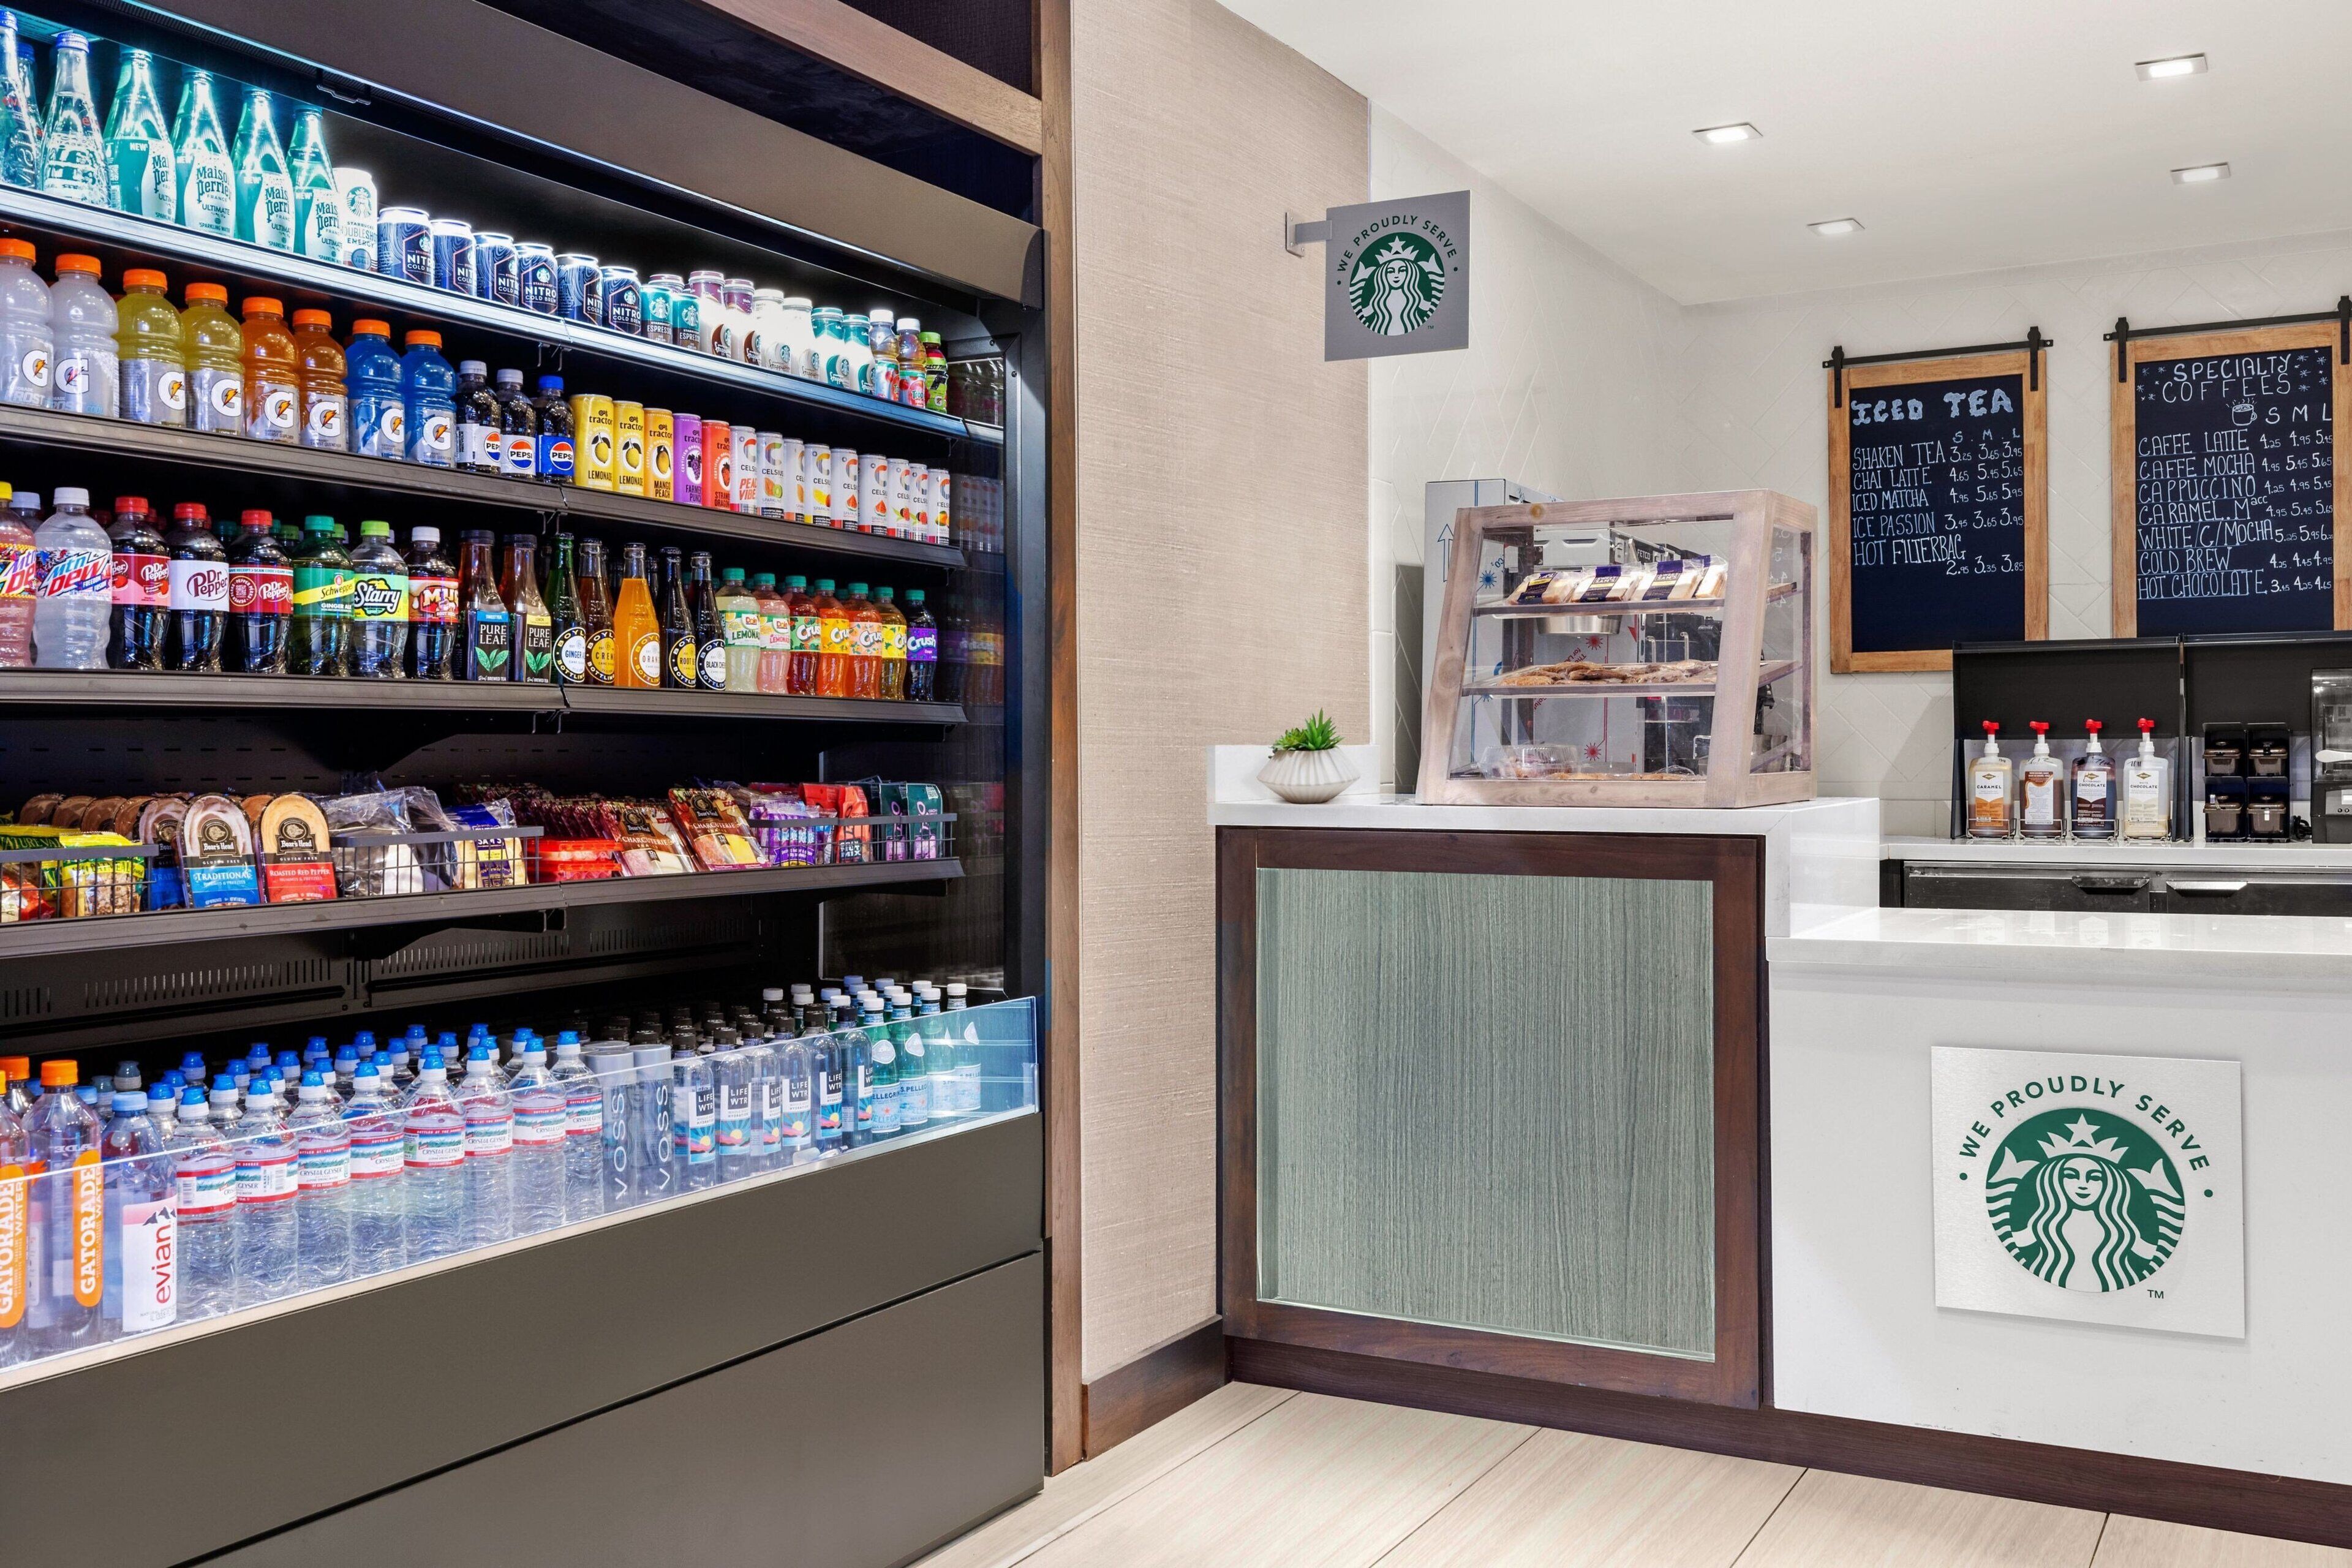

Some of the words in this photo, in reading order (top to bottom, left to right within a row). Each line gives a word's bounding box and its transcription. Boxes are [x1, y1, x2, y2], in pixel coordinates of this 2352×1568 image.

[202, 204, 230, 215] ULTIMATE
[347, 238, 374, 247] ENERGY
[1338, 250, 1353, 272] WE
[1354, 215, 1418, 246] PROUDLY
[1422, 221, 1457, 258] SERVE
[526, 287, 556, 297] NITRO
[612, 307, 640, 319] NITRO
[647, 325, 671, 334] ESPRESSO
[2173, 353, 2291, 382] SPECIALTY
[55, 358, 89, 394] G
[2162, 373, 2291, 404] COFFEES
[265, 391, 294, 428] G
[1850, 399, 1923, 426] ICED
[1943, 388, 2013, 418] TEA
[2266, 407, 2280, 424] S
[2292, 404, 2308, 422] M
[2323, 403, 2332, 421] L
[309, 402, 340, 437] G
[589, 416, 612, 425] tractor
[620, 421, 643, 431] tractor
[423, 417, 451, 450] G
[649, 430, 672, 439] tractor
[1952, 431, 1962, 443] S
[1983, 428, 1993, 440] M
[2013, 428, 2020, 439] L
[2138, 433, 2193, 458] CAFFE
[2204, 429, 2249, 452] LATTE
[2260, 434, 2281, 449] 4.25
[2290, 430, 2310, 447] 4.95
[1852, 444, 1904, 470] SHAKEN
[1912, 440, 1946, 466] TEA
[1950, 446, 1972, 462] 3.25
[1978, 443, 1999, 460] 3.65
[2003, 441, 2022, 458] 3.95
[2139, 456, 2197, 480] CAFFE
[2204, 453, 2255, 476] MOCHA
[2261, 458, 2280, 472] 4.95
[2286, 455, 2308, 470] 5.45
[2312, 453, 2332, 467] 5.65
[588, 470, 612, 481] LEMONADE
[619, 475, 643, 486] LEMONADE
[1853, 469, 1882, 491] CHAI
[1891, 466, 1932, 488] LATTE
[1950, 467, 1969, 483] 4.65
[1978, 463, 1999, 480] 5.45
[2001, 461, 2024, 479] 5.65
[654, 481, 671, 491] MANGO
[655, 489, 670, 498] PEACH
[2139, 475, 2256, 504] CAPPUCCINO
[2264, 480, 2285, 495] 4.25
[2290, 478, 2310, 492] 4.95
[2313, 476, 2332, 490] 5.45
[1852, 492, 1877, 512] ICED
[1882, 489, 1929, 510] MATCHA
[1950, 488, 1969, 503] 4.95
[1975, 485, 1998, 502] 5.65
[2002, 483, 2023, 499] 5.95
[2266, 505, 2287, 517] 4.95
[2291, 502, 2313, 516] 5.45
[2316, 500, 2333, 514] 5.65
[1853, 515, 1875, 538] ICE
[1880, 511, 1936, 537] PASSION
[1945, 514, 1967, 530] 3.45
[1973, 510, 1997, 529] 3.65
[2000, 508, 2024, 526] 3.95
[2275, 529, 2297, 543] 5.25
[2299, 525, 2320, 541] 5.95
[1637, 549, 1651, 560] FETCO
[1854, 539, 1886, 566] HOT
[1892, 533, 1966, 564] FILTERBAG
[154, 562, 163, 571] Dr
[1947, 560, 1969, 575] 2.95
[1974, 555, 1997, 574] 3.35
[2002, 554, 2024, 573] 3.85
[2139, 549, 2180, 575] COLD
[2185, 546, 2233, 573] BREW
[2269, 553, 2287, 568] 4.25
[2293, 552, 2312, 567] 4.45
[2313, 550, 2334, 567] 4.95
[194, 572, 228, 597] Pepper
[207, 570, 221, 584] Dr
[2138, 574, 2166, 599] HOT
[2171, 569, 2267, 597] CHOCOLATE
[2271, 579, 2290, 593] 3.45
[2294, 576, 2313, 591] 4.25
[2315, 576, 2332, 590] 4.65
[263, 584, 287, 600] Pepper
[271, 582, 282, 590] Dr
[355, 582, 400, 612] Starry
[480, 625, 507, 635] PURE
[777, 620, 788, 629] Dole
[480, 635, 507, 644] LEAF.
[529, 628, 550, 638] PURE
[529, 638, 549, 647] LEAF.
[908, 635, 936, 649] Crush
[203, 843, 219, 851] Boar's
[622, 837, 668, 846] CHARCUTERIE
[197, 870, 252, 881] TRADITIONAL
[828, 1073, 842, 1082] LIFE
[731, 1088, 748, 1096] LIFE
[828, 1082, 842, 1091] WTR
[698, 1093, 714, 1102] LIFE
[698, 1102, 714, 1112] WTR
[1959, 1120, 1991, 1159] WE
[1990, 1075, 2125, 1118] PROUDLY
[2135, 1095, 2210, 1171] SERVE
[657, 1083, 671, 1190] VOSS
[612, 1092, 627, 1199] VOSS
[15, 1181, 24, 1236] WATER
[80, 1167, 96, 1295] GATORADE
[0, 1182, 13, 1314] GATORADE
[151, 1224, 172, 1305] evian
[2147, 1289, 2165, 1299] TM
